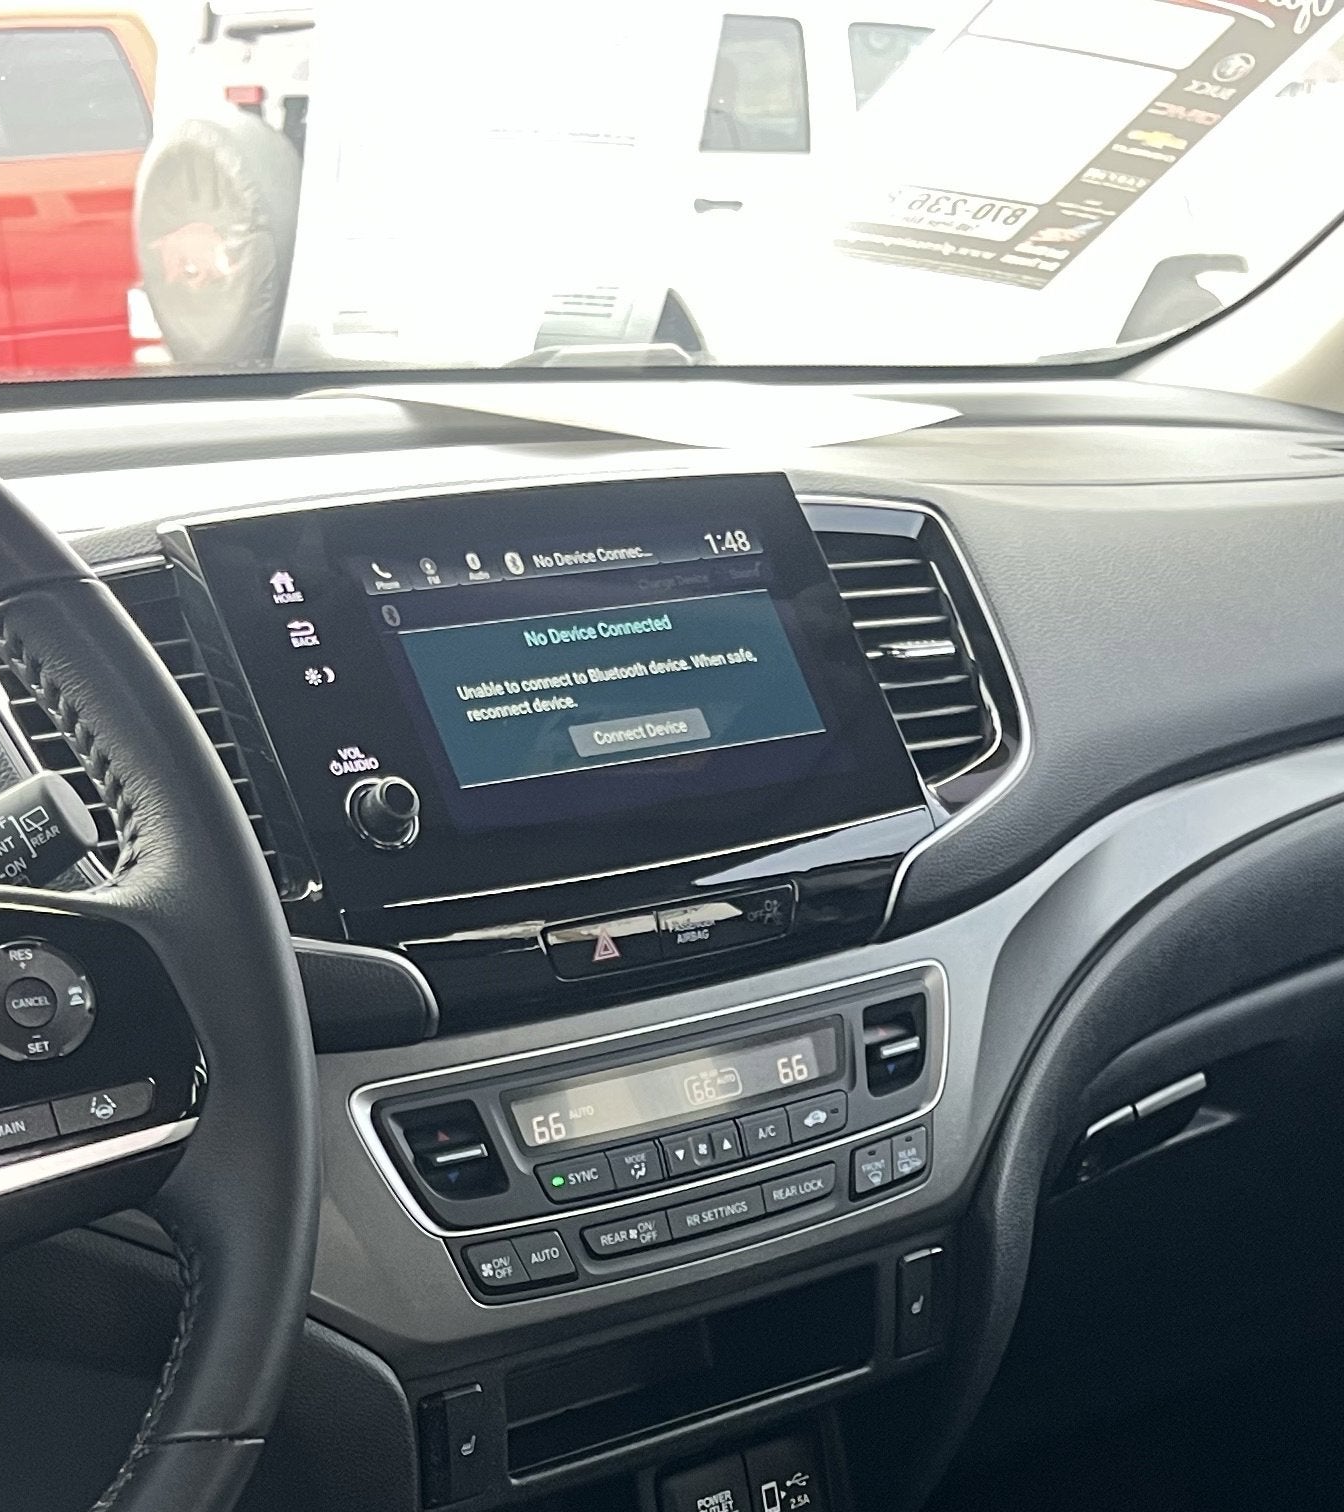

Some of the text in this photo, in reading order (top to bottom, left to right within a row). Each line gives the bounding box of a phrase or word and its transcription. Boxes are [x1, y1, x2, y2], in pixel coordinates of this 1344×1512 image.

[704, 530, 751, 555] 1:48
[532, 554, 554, 569] No
[555, 548, 595, 567] Device
[272, 591, 304, 604] HOME
[523, 614, 672, 647] No Device Connected
[290, 635, 320, 648] BACK
[456, 647, 758, 701] Unable to connect to Bluetooth device. When safe,
[466, 695, 578, 722] reconnect device.
[593, 719, 688, 745] Connect Device
[337, 747, 365, 761] VOL
[343, 757, 379, 773] AUDIO
[30, 825, 61, 849] REAR
[4, 857, 28, 879] ON
[677, 929, 710, 944] AIRBAG
[9, 948, 33, 962] RES
[11, 996, 51, 1010] CANCEL
[27, 1041, 50, 1055] SET
[777, 1054, 808, 1084] 66
[692, 1080, 716, 1102] 66
[532, 1105, 594, 1144] 66 AUTO
[758, 1125, 777, 1140] A/C
[624, 1153, 646, 1164] MODE
[898, 1148, 917, 1159] REAR
[861, 1159, 886, 1172] FRONT
[567, 1168, 599, 1185] SYNC
[772, 1179, 825, 1200] REAR LOCK
[686, 1201, 748, 1227] RR SETTINGS
[600, 1230, 628, 1246] REAR
[639, 1230, 658, 1244] OFF
[530, 1247, 560, 1264] AUTO
[494, 1266, 513, 1279] OFF
[697, 1489, 732, 1509] POWER
